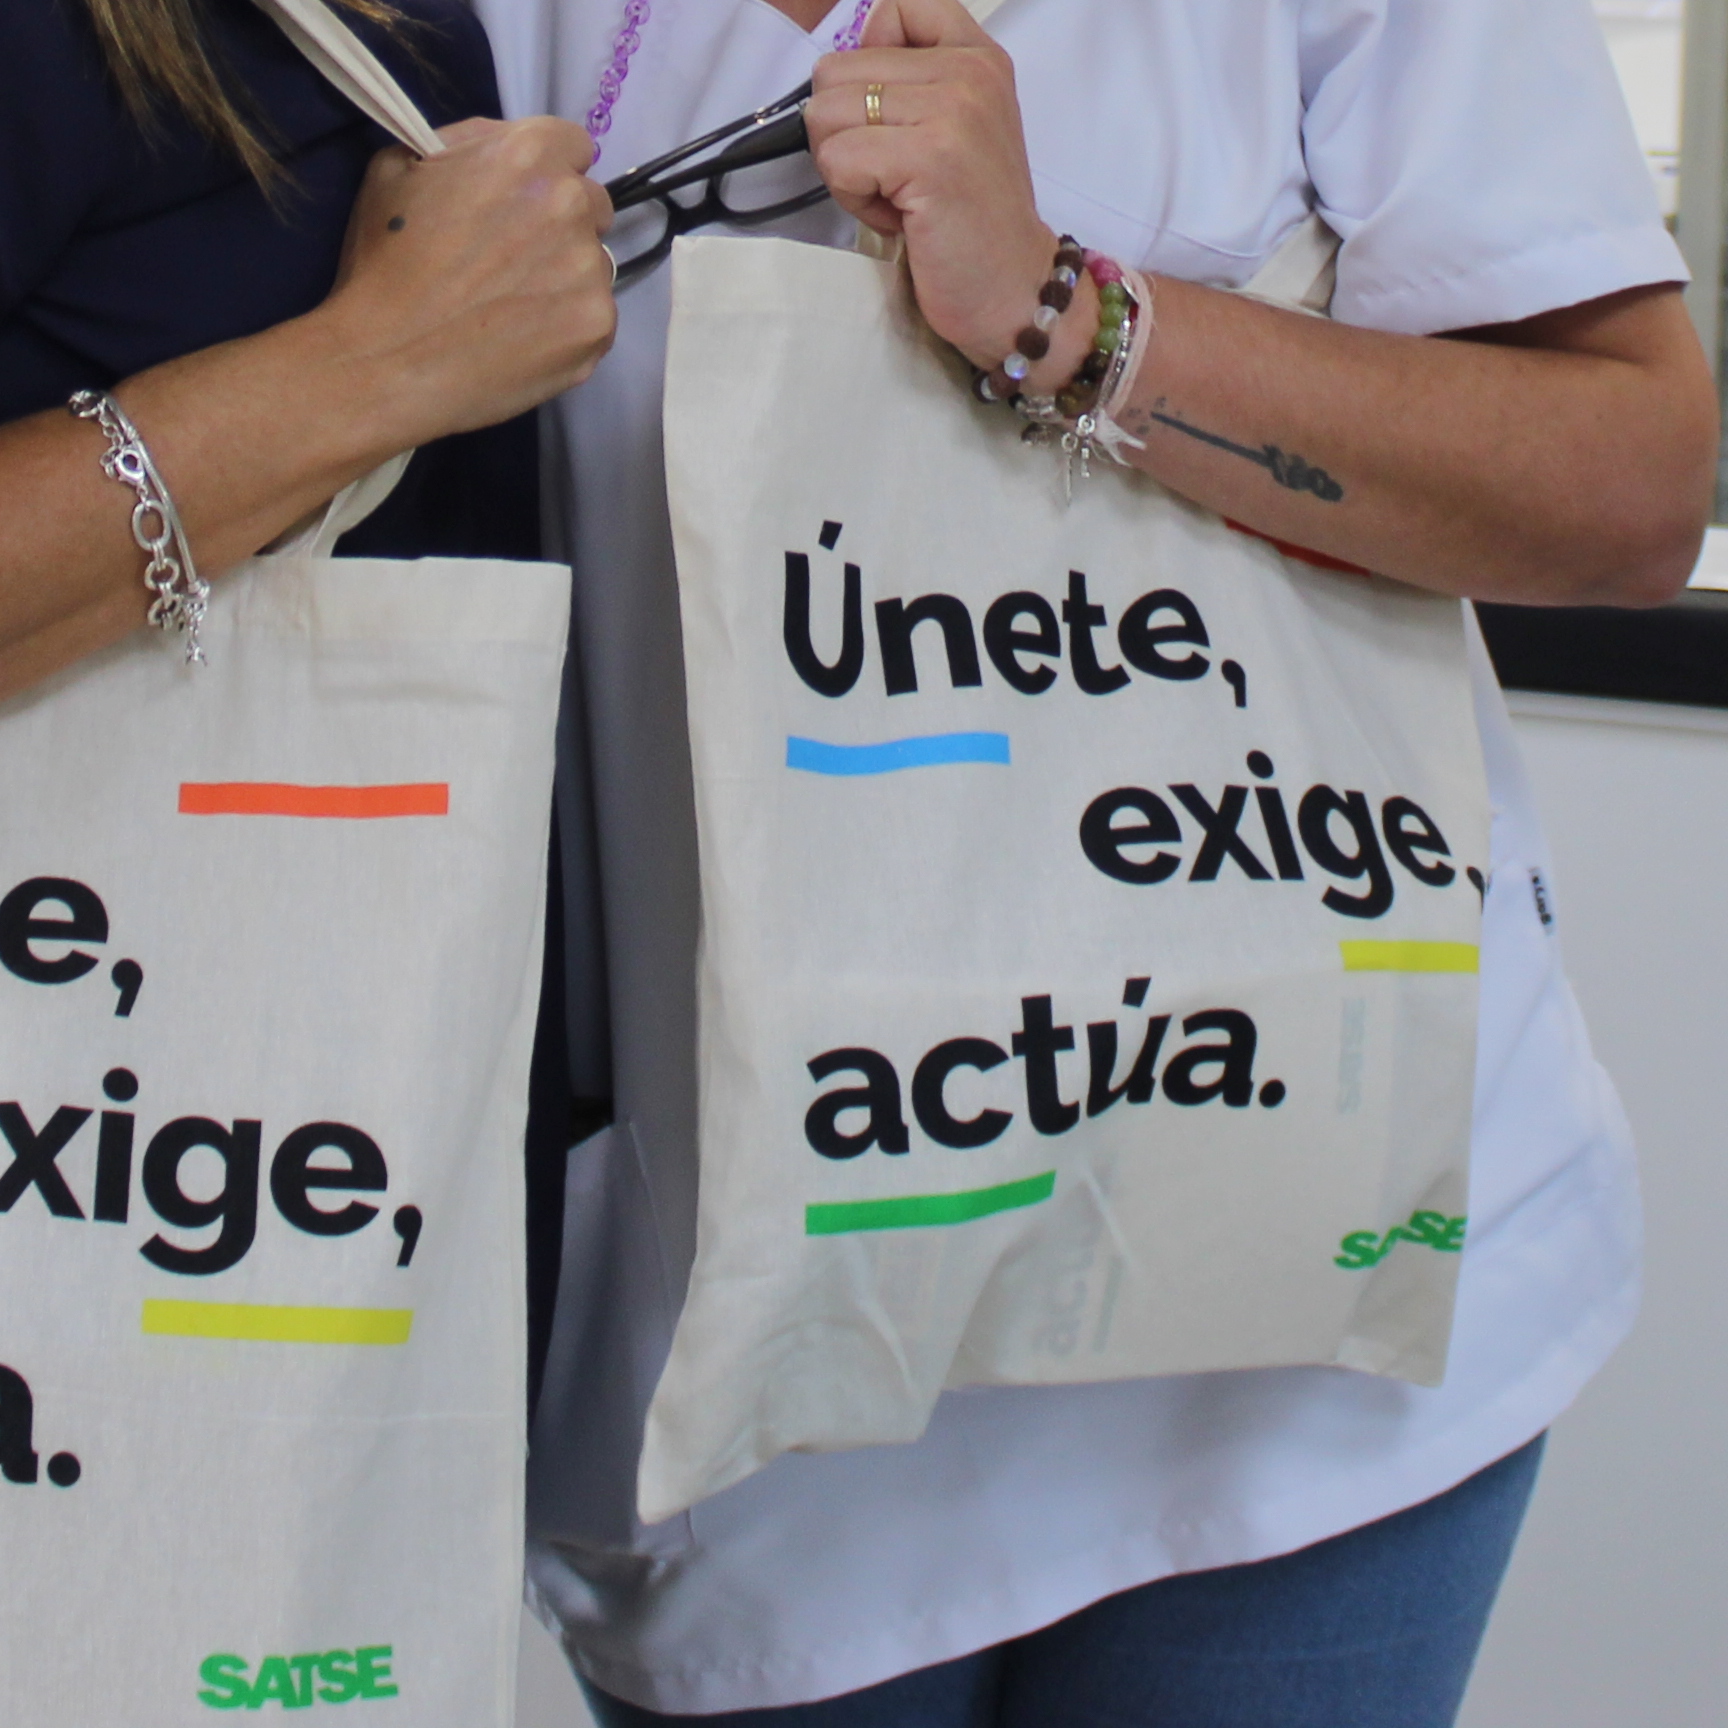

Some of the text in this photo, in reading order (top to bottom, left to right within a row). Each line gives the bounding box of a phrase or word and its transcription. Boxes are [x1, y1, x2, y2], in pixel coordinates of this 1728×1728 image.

[783, 521, 1248, 709] Únete,
[1078, 750, 1484, 920] exige,
[803, 976, 1287, 1161] actúa.
[197, 1644, 399, 1710] SATSE
